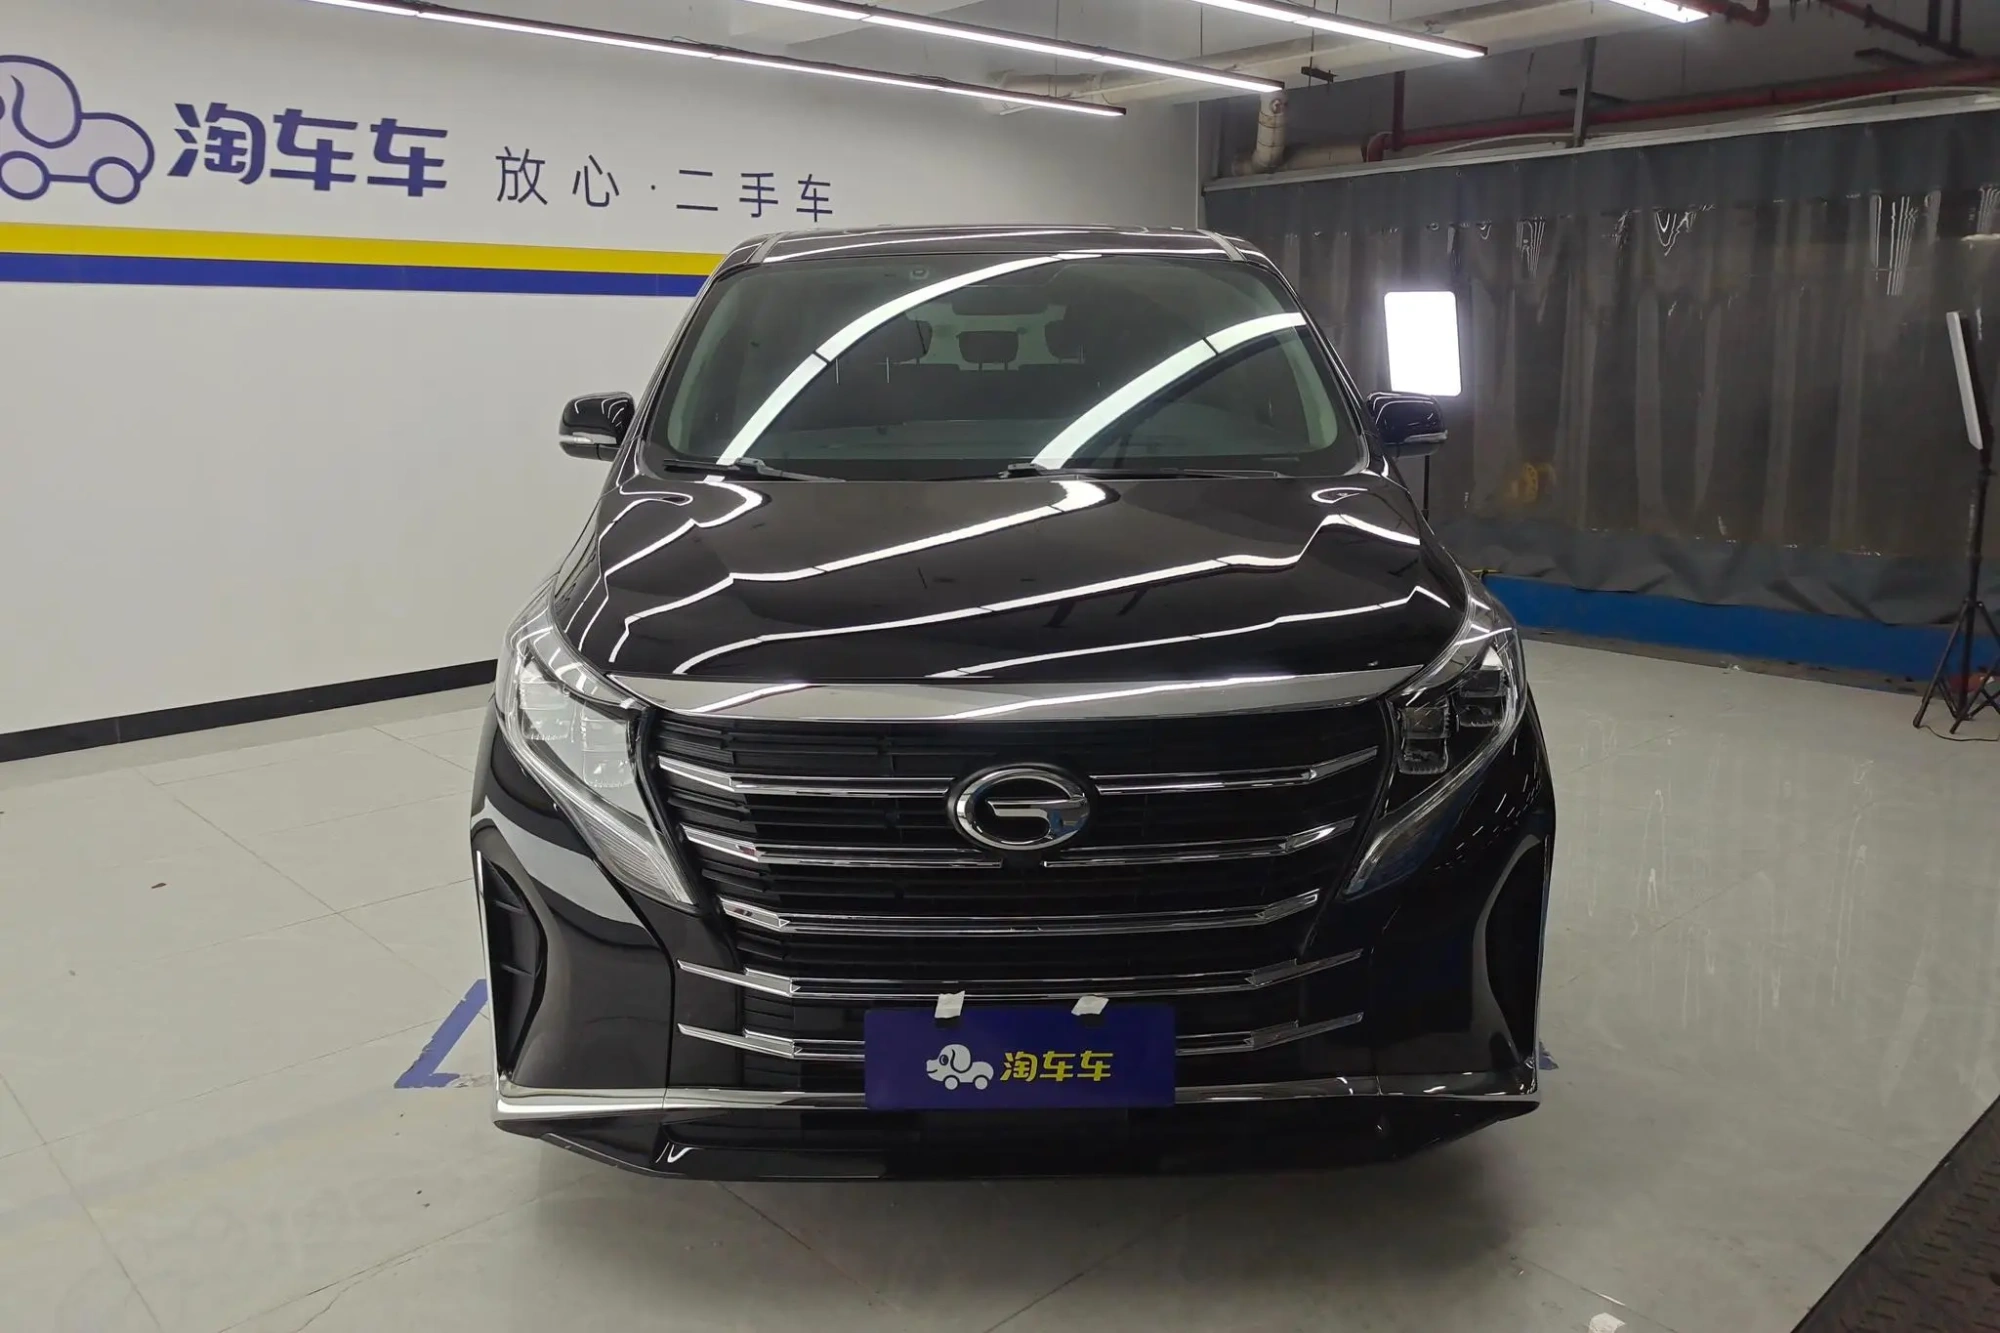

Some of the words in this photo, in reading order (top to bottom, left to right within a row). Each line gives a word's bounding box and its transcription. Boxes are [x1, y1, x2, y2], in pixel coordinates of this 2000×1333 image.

[167, 102, 449, 198] 淘车车
[1000, 1050, 1114, 1082] 淘车车
